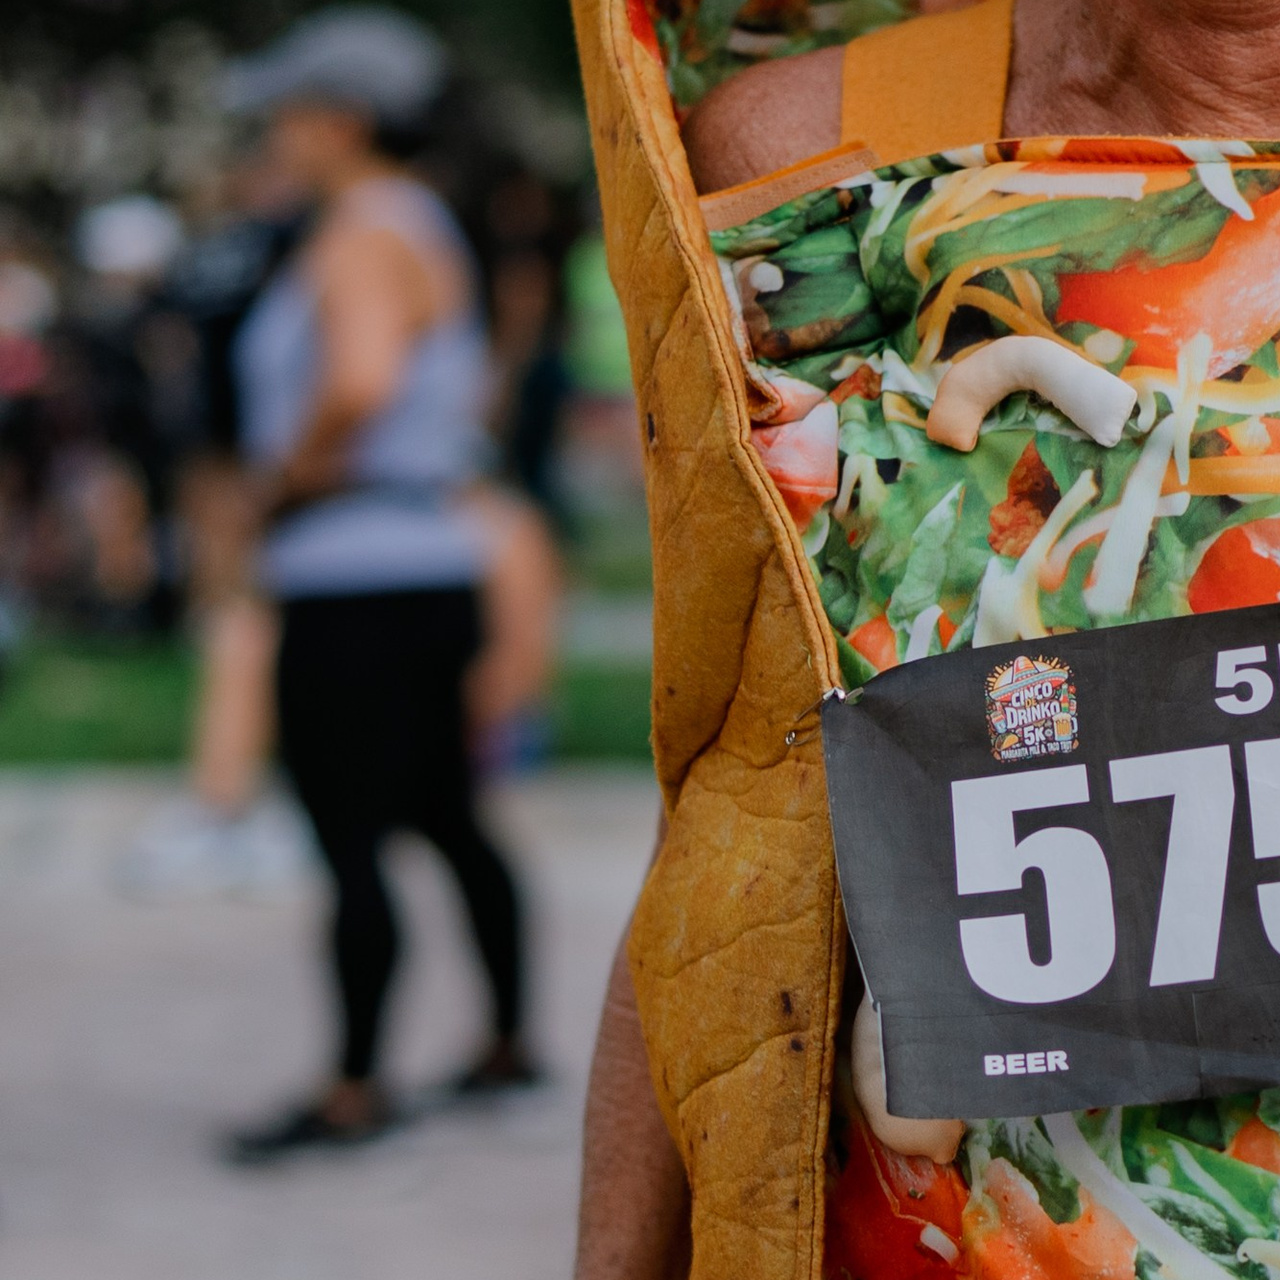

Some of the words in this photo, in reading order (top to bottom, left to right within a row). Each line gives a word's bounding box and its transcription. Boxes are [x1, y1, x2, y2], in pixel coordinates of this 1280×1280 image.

[1011, 681, 1053, 707] CINCO
[1025, 699, 1037, 708] DE
[1005, 701, 1060, 729] DRINKO
[1023, 726, 1046, 746] 5K
[983, 1050, 1070, 1076] BEER
